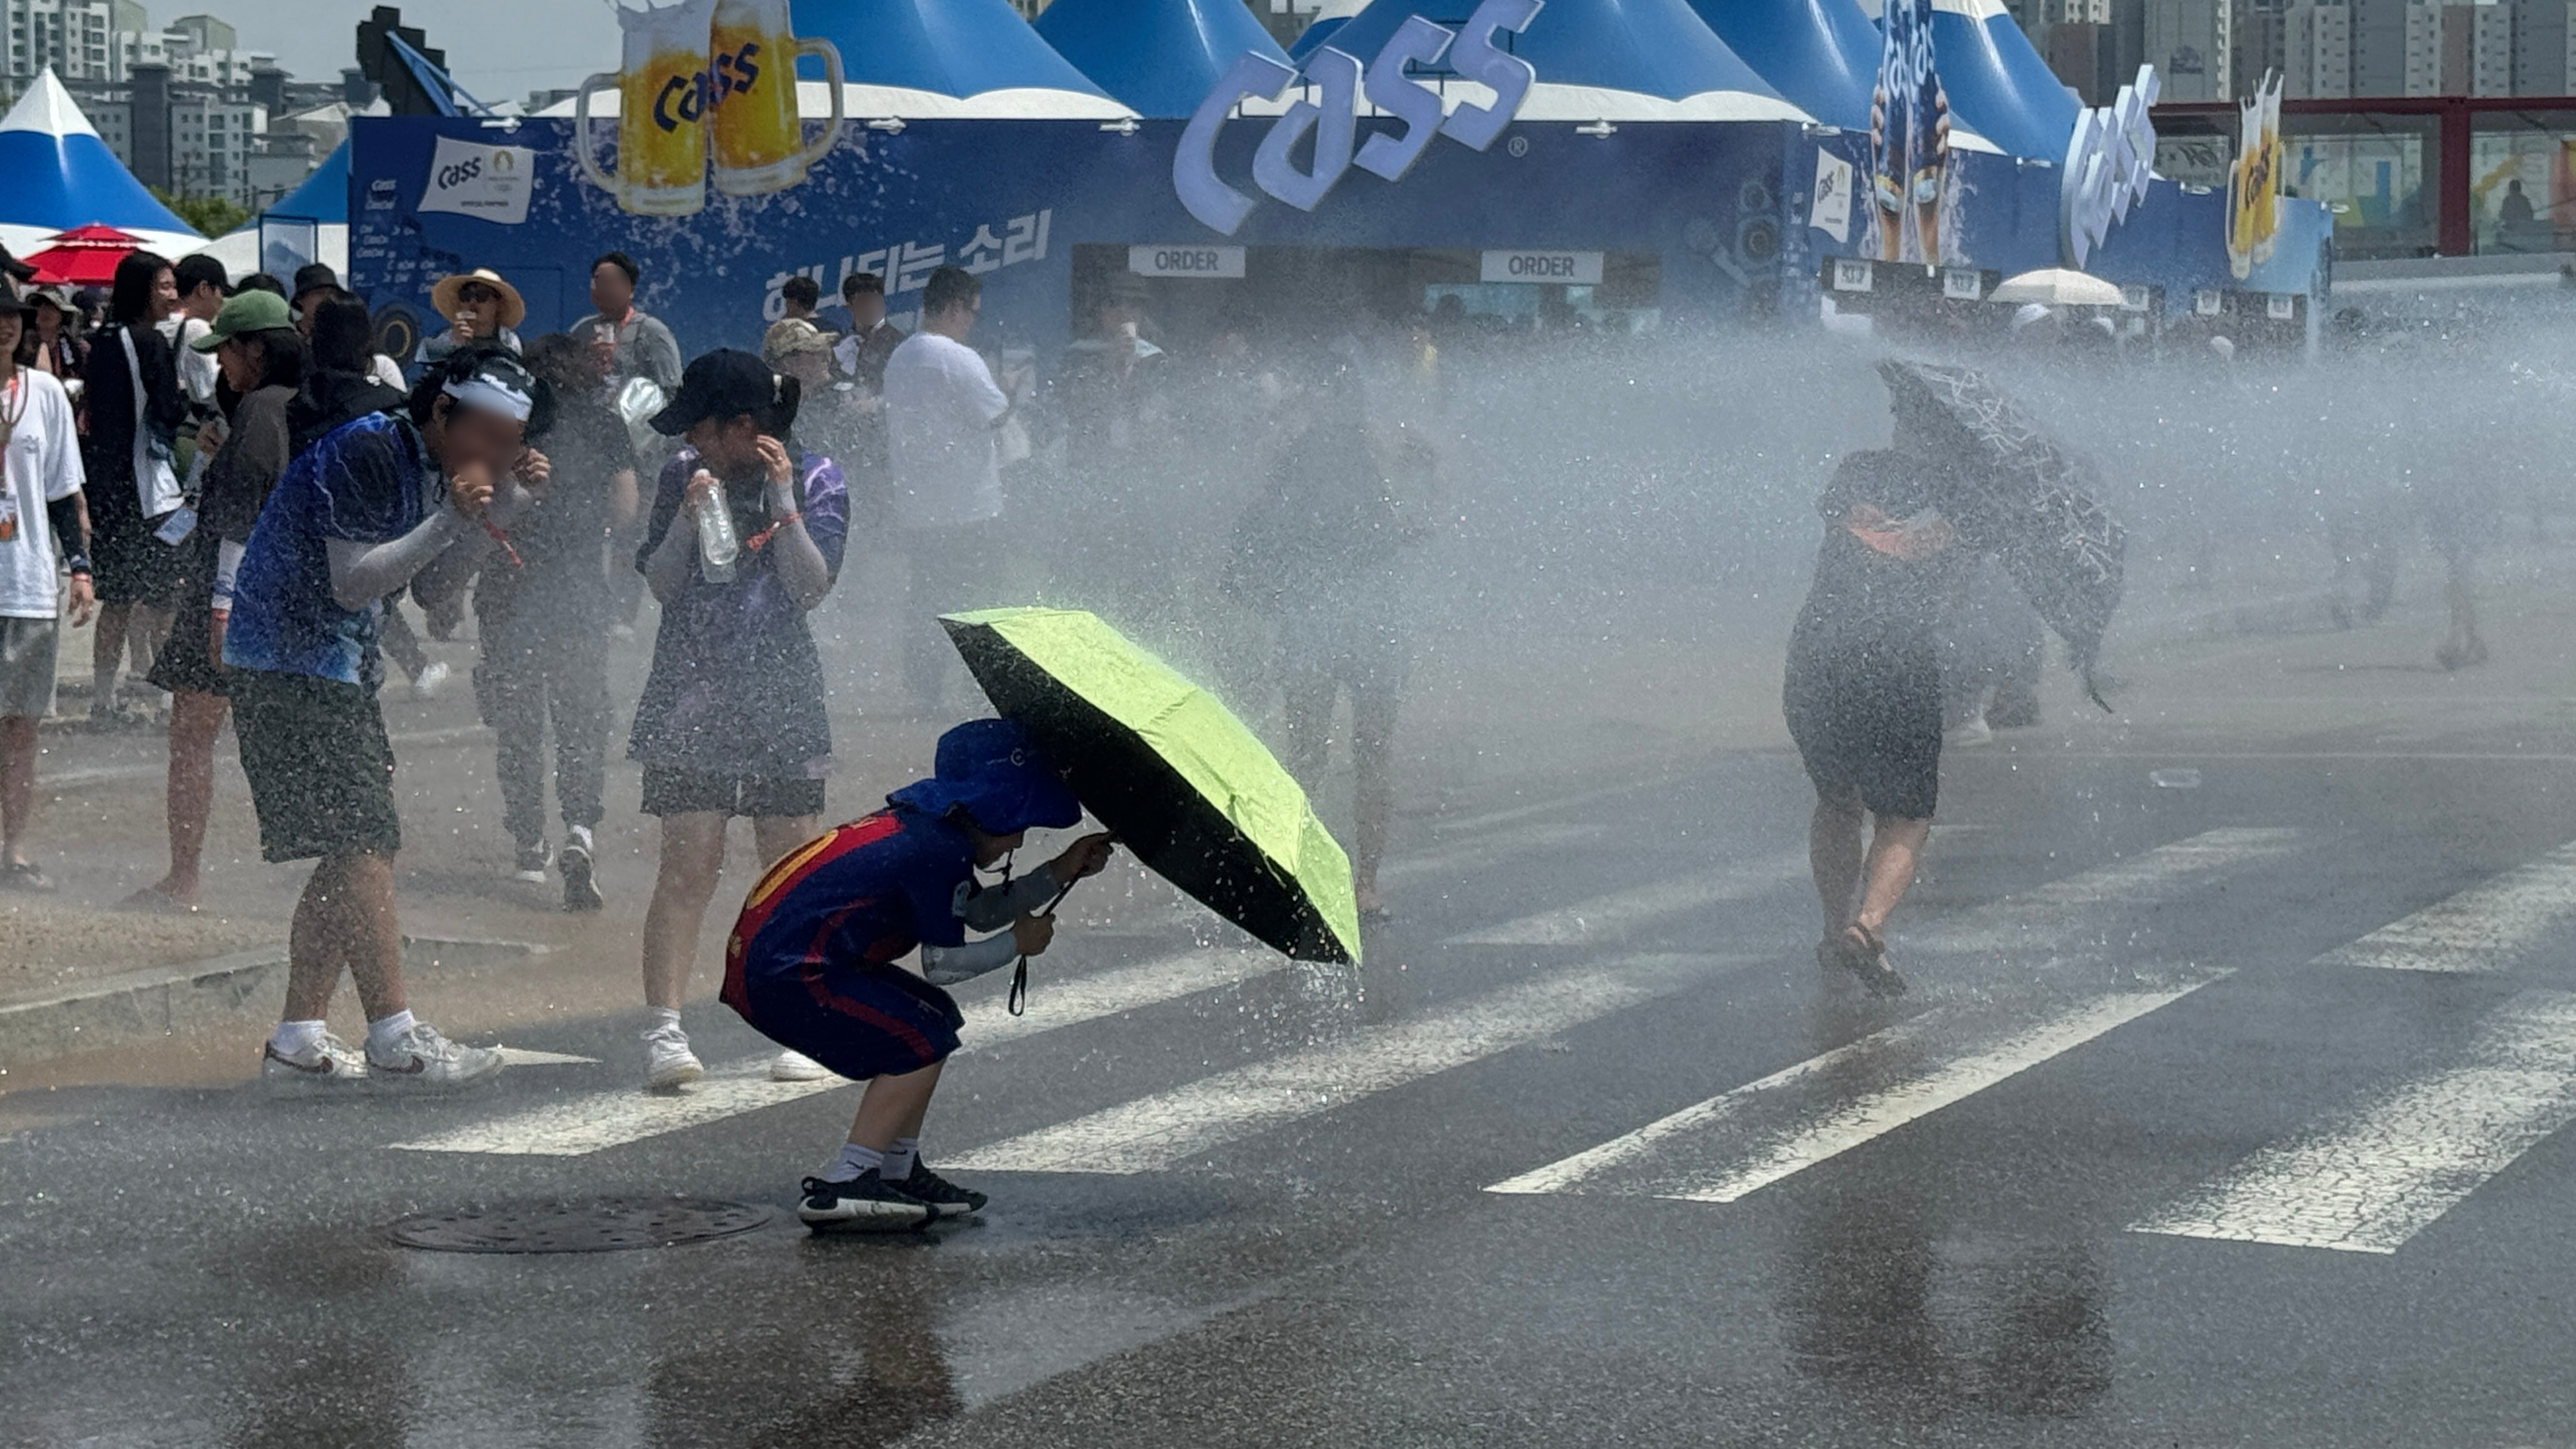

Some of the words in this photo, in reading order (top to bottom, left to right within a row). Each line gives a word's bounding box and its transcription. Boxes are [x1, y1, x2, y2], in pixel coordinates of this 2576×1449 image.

[960, 209, 1052, 274] 소리
[1155, 251, 1219, 271] ORDER
[1508, 255, 1575, 277] ORDER
